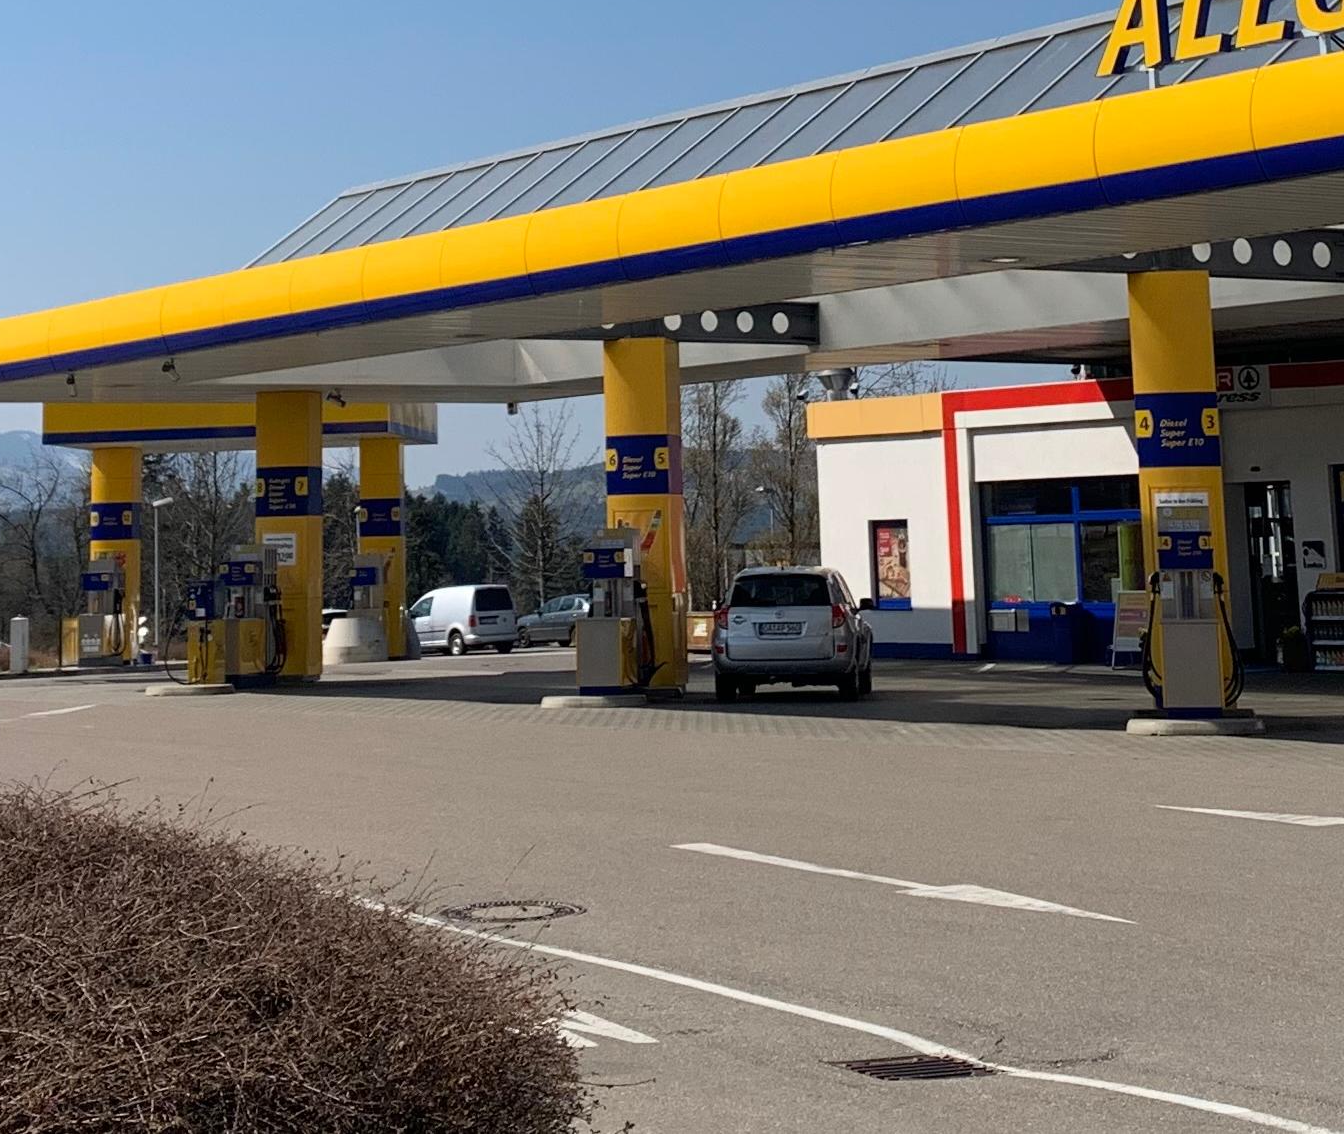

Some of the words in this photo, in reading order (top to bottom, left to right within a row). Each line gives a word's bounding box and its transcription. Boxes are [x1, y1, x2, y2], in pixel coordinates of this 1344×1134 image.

[1139, 417, 1149, 430] 4
[1160, 418, 1187, 427] Diesel
[1206, 415, 1215, 429] 3
[1160, 429, 1185, 438] Super
[1161, 438, 1186, 449] Super
[1187, 438, 1205, 447] E10
[609, 454, 616, 465] 6
[658, 453, 664, 464] 5
